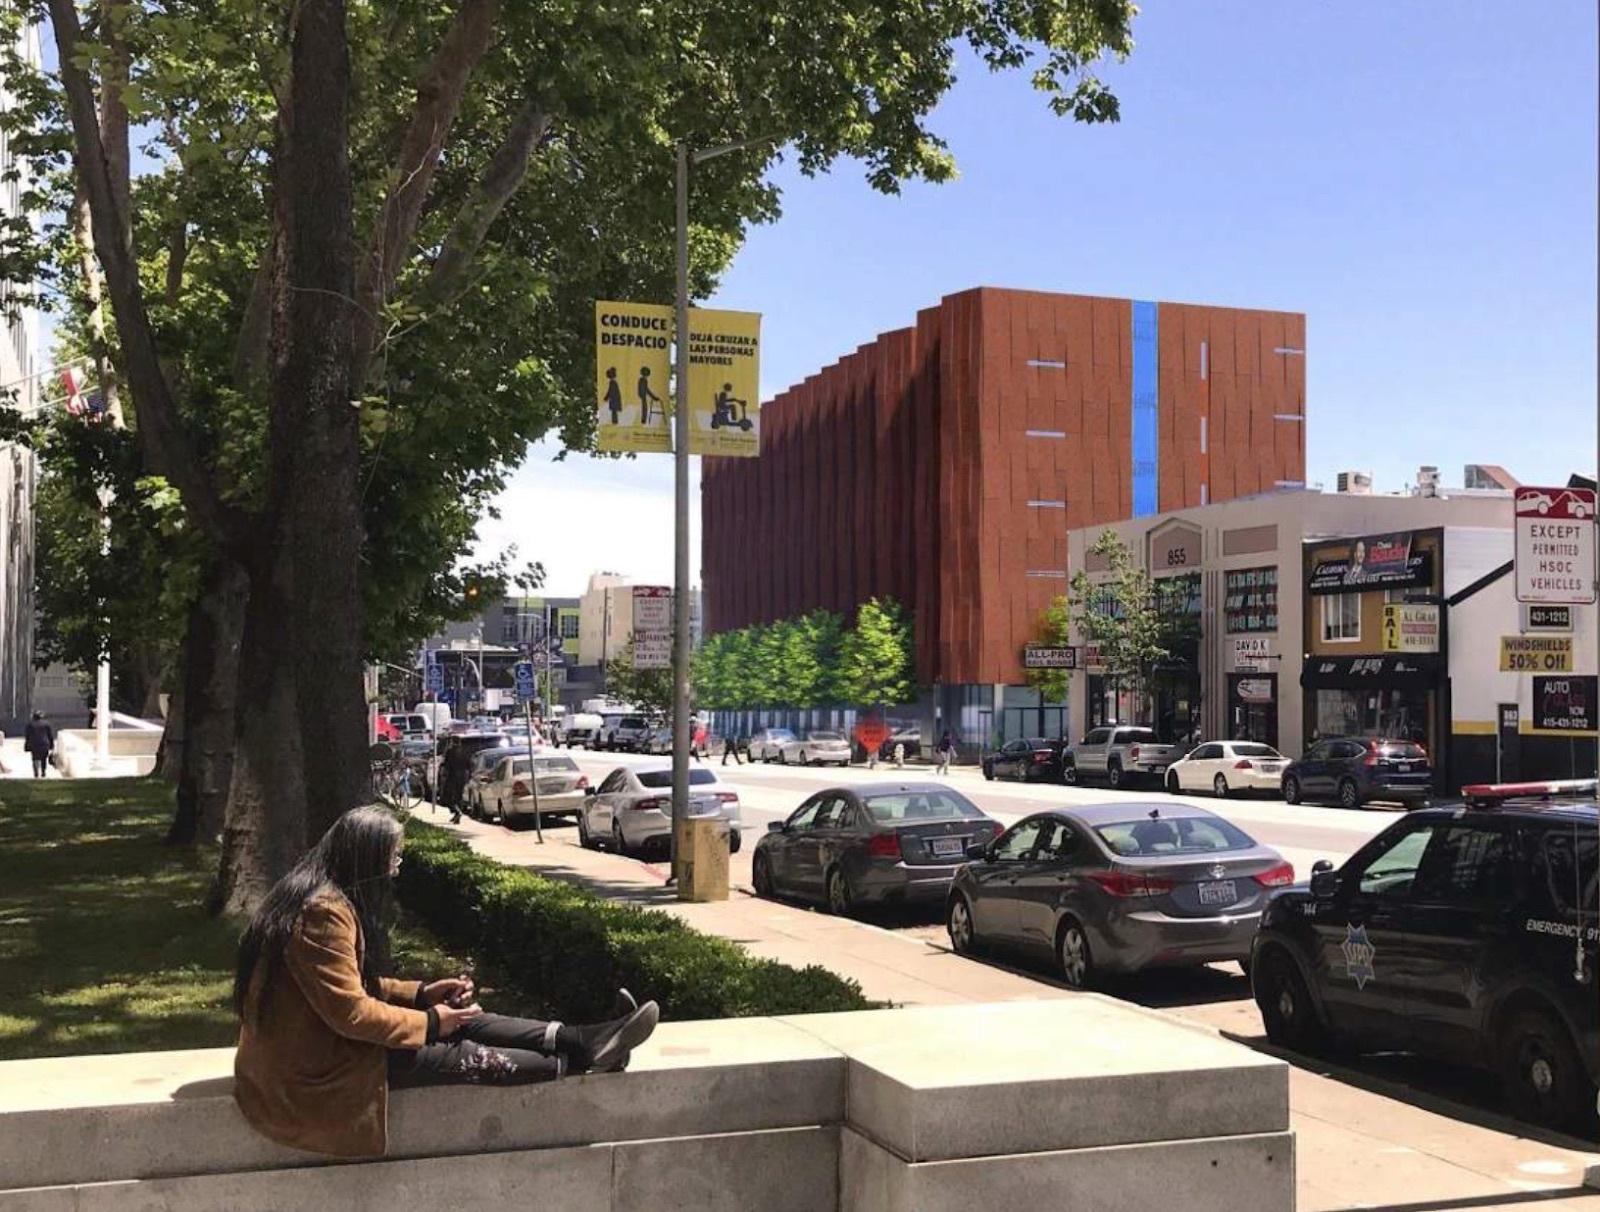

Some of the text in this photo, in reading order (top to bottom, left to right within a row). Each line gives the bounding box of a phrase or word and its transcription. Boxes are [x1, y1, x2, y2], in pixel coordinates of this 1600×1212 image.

[601, 314, 667, 331] CONDUCE
[601, 332, 667, 349] DESPACIO
[690, 333, 758, 346] DEJA CRUZAR A
[689, 344, 754, 356] LAS PERSONAS
[689, 355, 733, 366] MAYORES
[1530, 524, 1580, 539] EXCEPT
[1167, 547, 1186, 565] 855
[1532, 543, 1579, 556] PERMITTED
[1539, 560, 1573, 574] HSOC
[1530, 577, 1582, 591] VEHICLES
[1530, 610, 1568, 622] 431-1212
[1384, 606, 1398, 650] BAIL
[1504, 639, 1571, 652] WINDSHIELDS
[1027, 649, 1073, 659] ALL-PRO
[1508, 653, 1539, 669] 50%
[1544, 680, 1570, 694] AUTO
[1568, 705, 1585, 716] NOW
[1526, 918, 1582, 938] EMERGENCY
